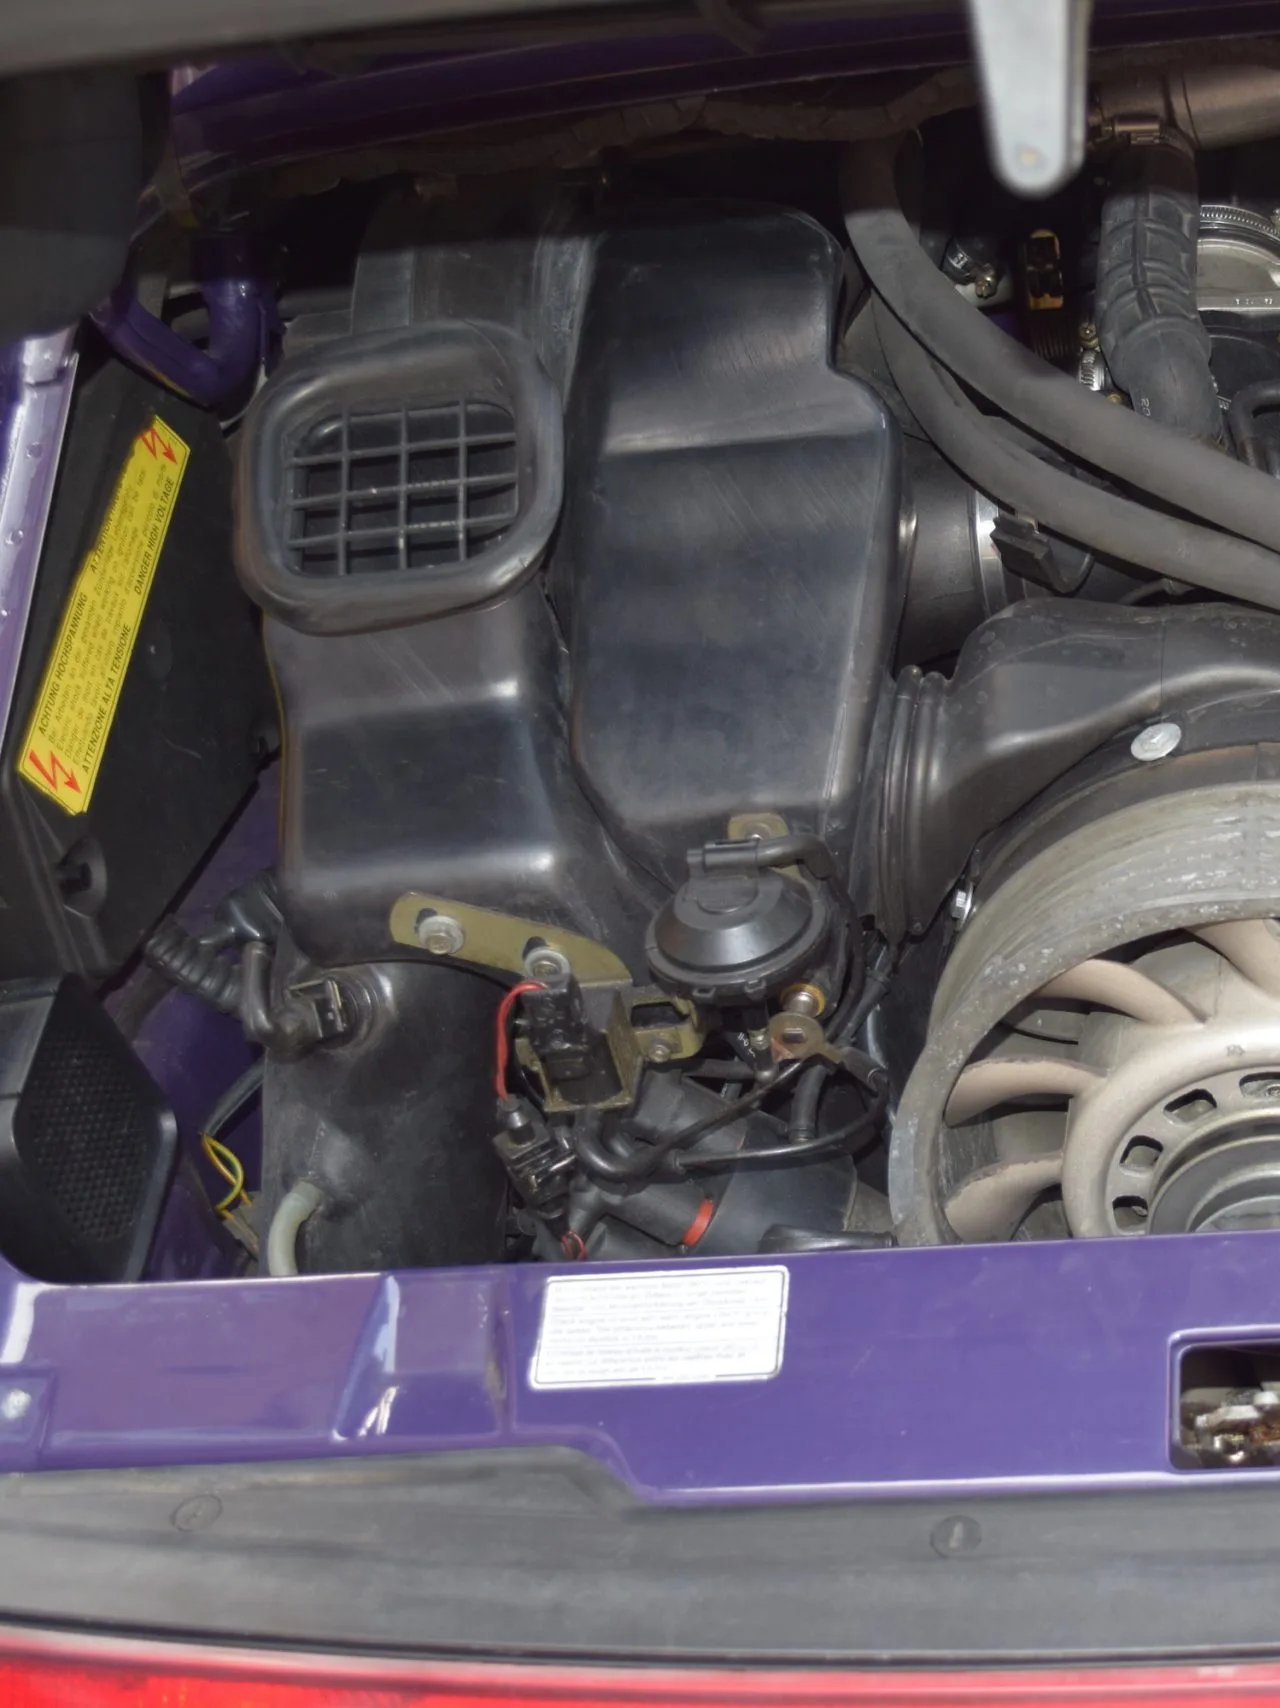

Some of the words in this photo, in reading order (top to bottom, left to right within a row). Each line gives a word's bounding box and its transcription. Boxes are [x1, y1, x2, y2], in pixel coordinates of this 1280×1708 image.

[134, 551, 152, 595] DANGER
[147, 524, 159, 550] HIGH
[155, 477, 174, 523] VOLTAGE
[38, 681, 60, 735] ACHTUNG
[55, 592, 87, 680] HOCHSPANNUNG
[82, 706, 107, 774] ATTENZIONE
[102, 677, 115, 705] ALTA
[110, 624, 130, 674] TENSIONE
